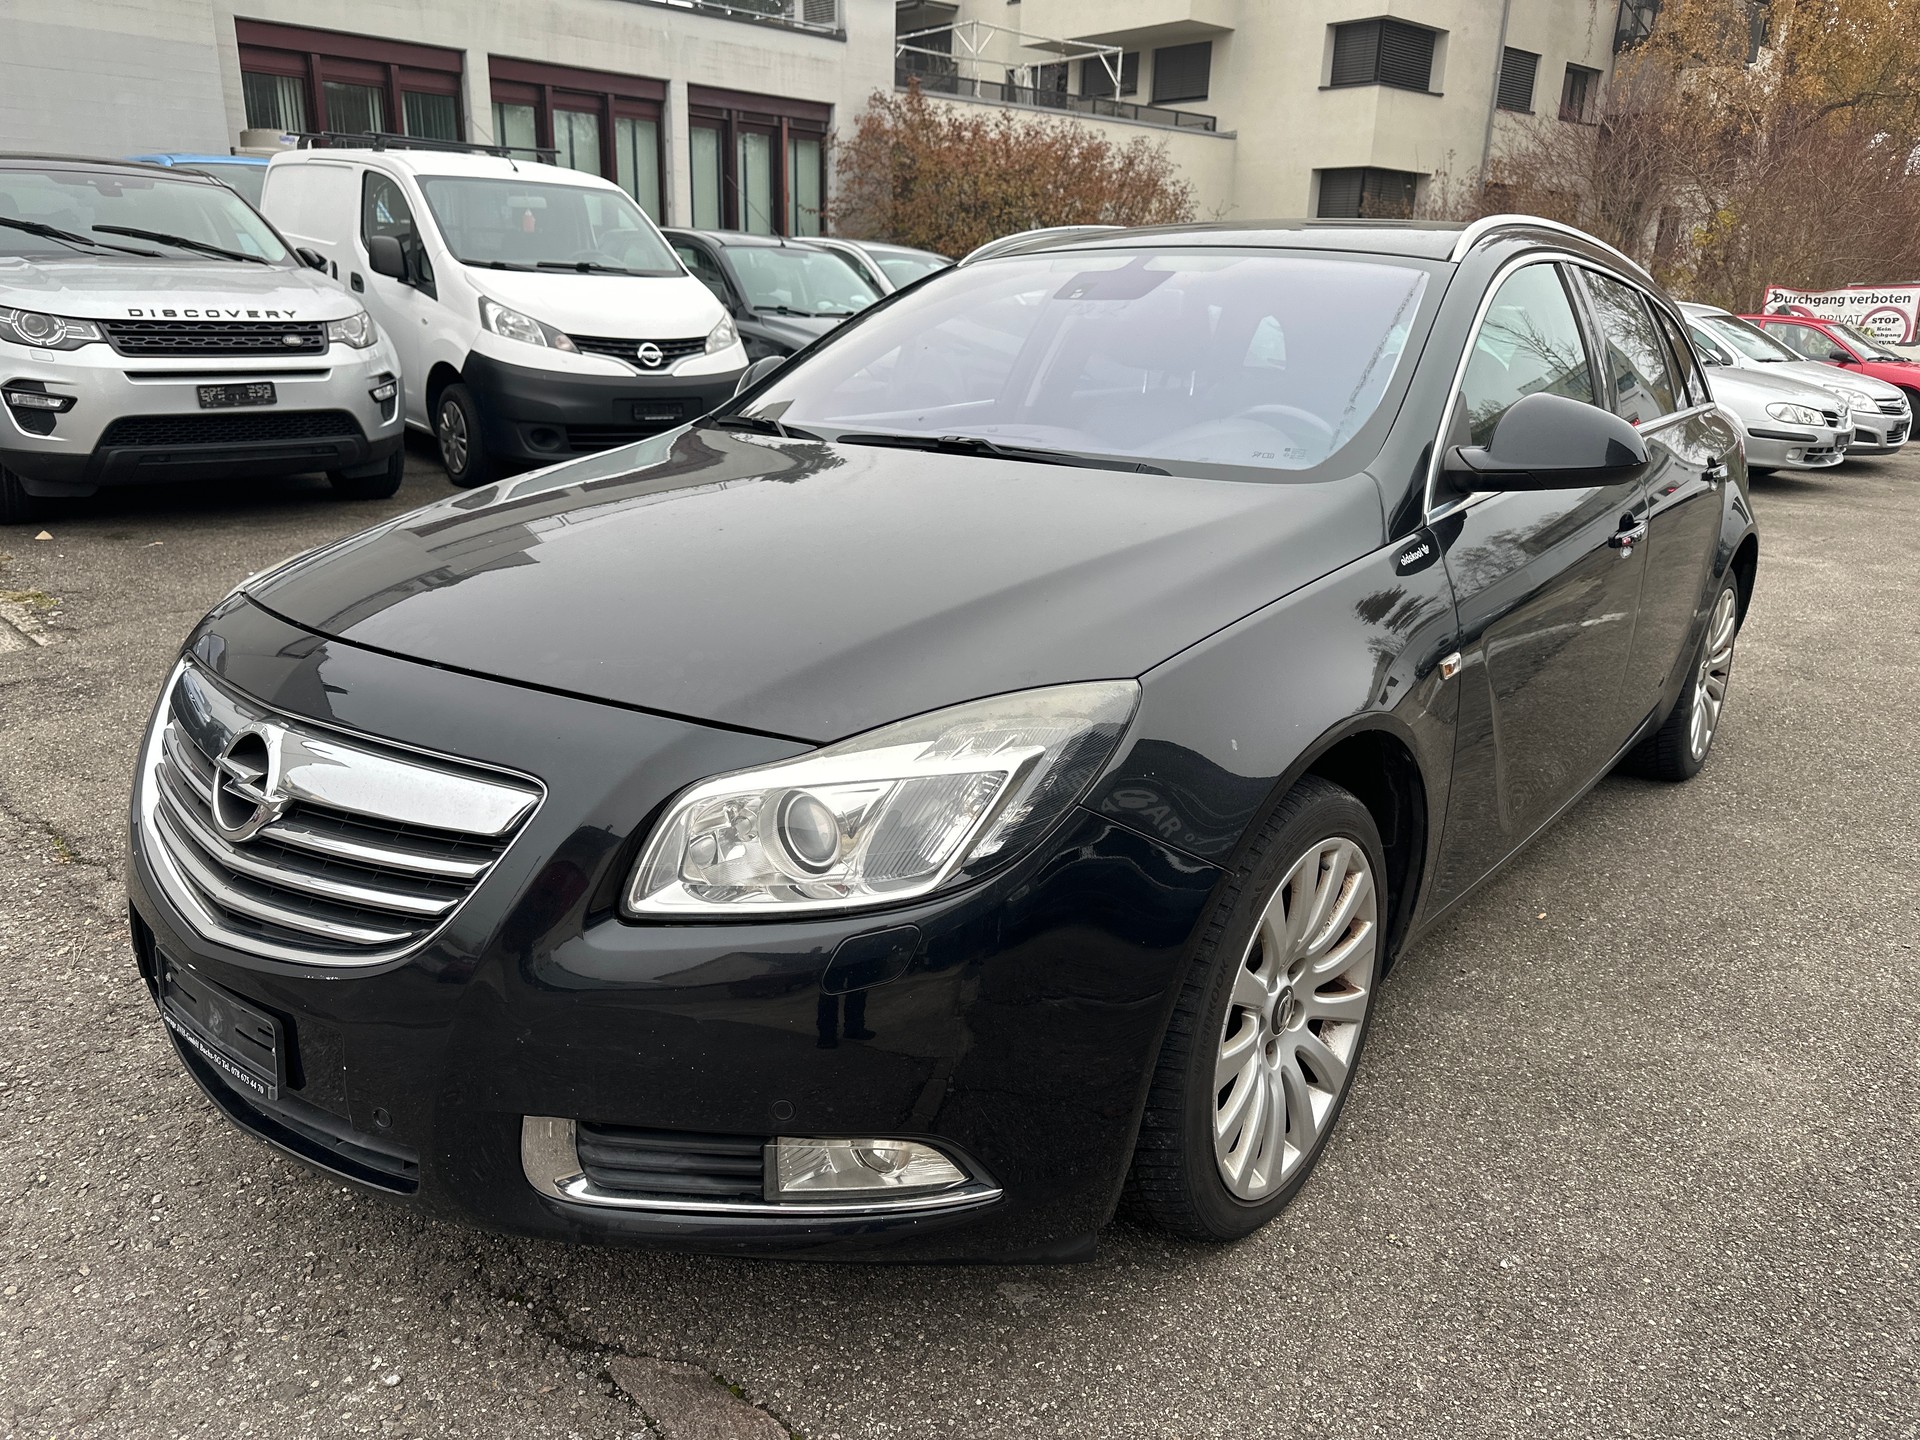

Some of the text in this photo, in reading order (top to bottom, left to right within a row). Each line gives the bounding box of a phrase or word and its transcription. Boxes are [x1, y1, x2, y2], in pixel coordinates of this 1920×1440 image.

[1774, 292, 1912, 307] Durchgang verboten
[128, 308, 297, 319] DISCOVERY
[240, 1073, 250, 1085] 675
[250, 1079, 258, 1090] 44
